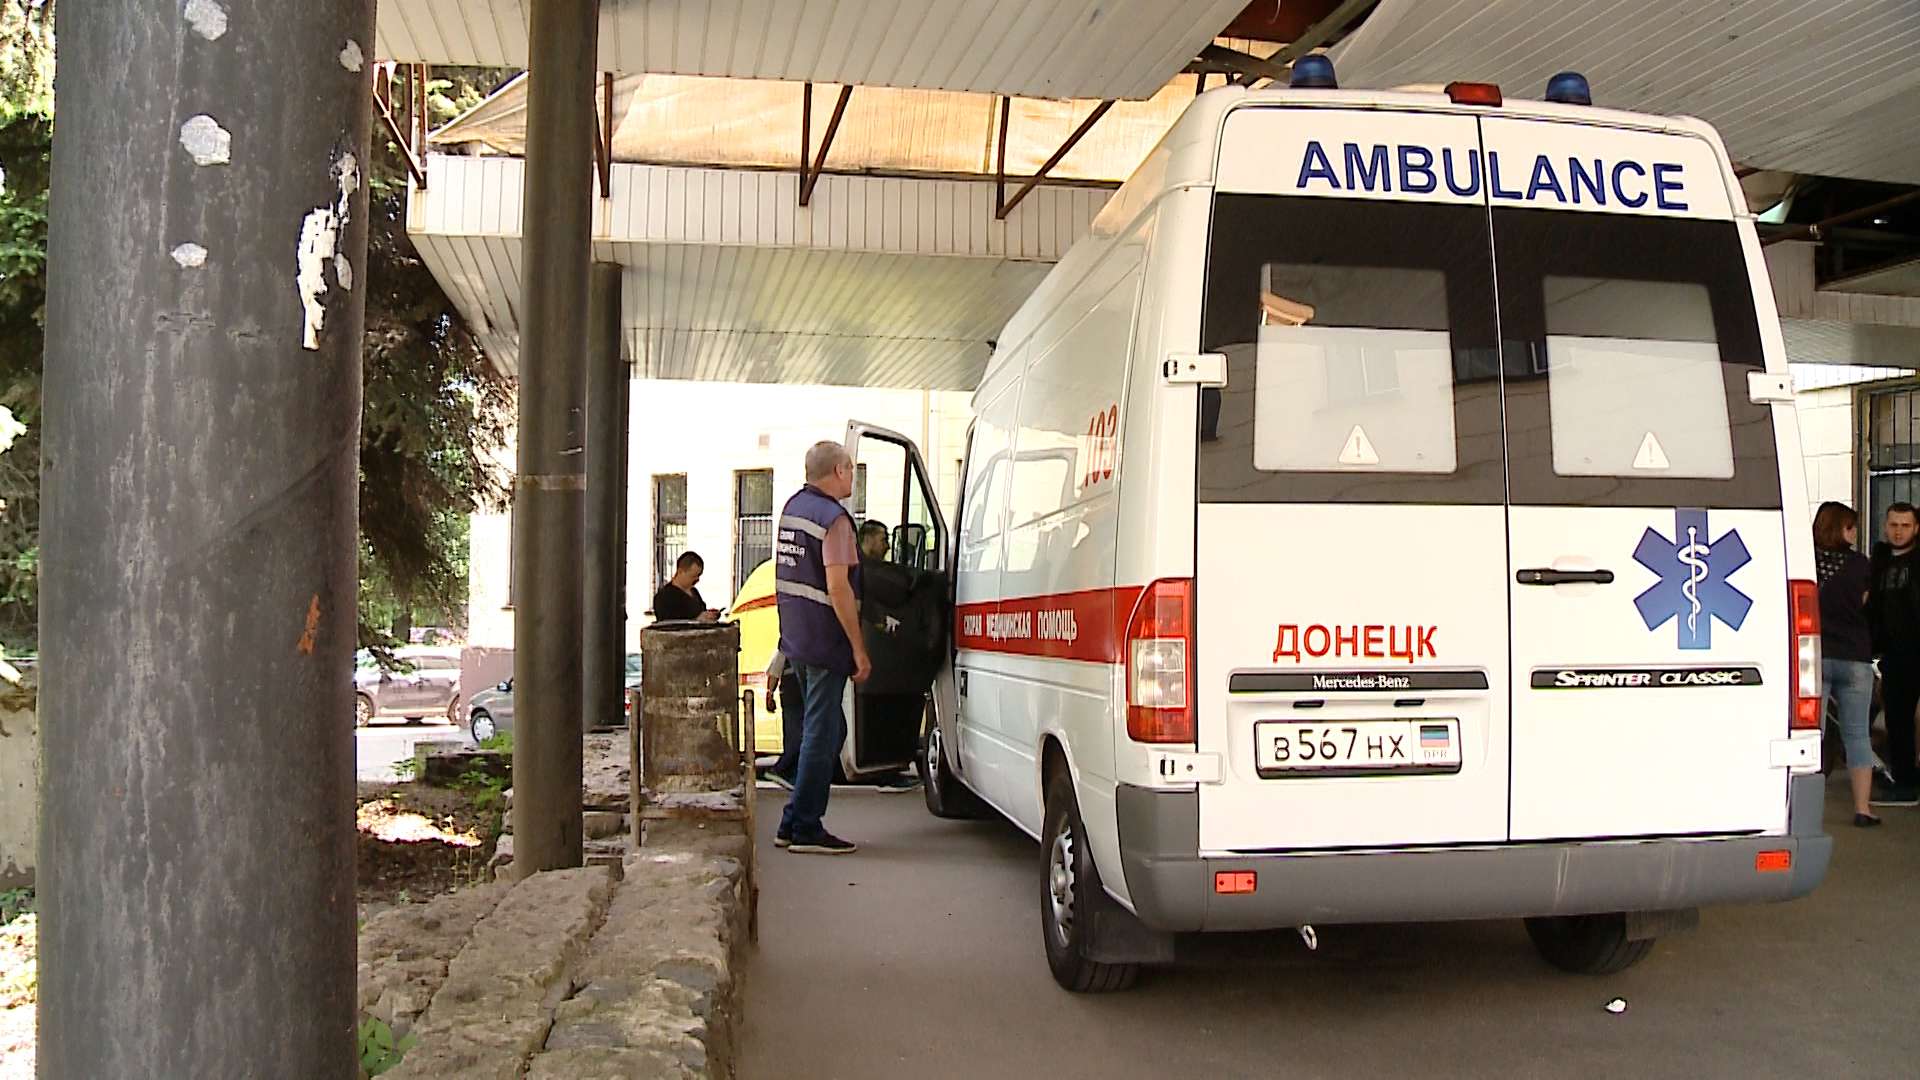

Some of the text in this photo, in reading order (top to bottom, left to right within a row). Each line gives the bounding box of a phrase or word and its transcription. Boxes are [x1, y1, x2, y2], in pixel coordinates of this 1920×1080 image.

[1296, 140, 1689, 211] AMBULANCE
[1037, 609, 1077, 646] ПОМОЩЬ
[1273, 624, 1438, 663] ДОНЕЦК
[1312, 675, 1409, 689] Mercedes-Benz
[1554, 670, 1743, 687] SPRINTER CLASSIC
